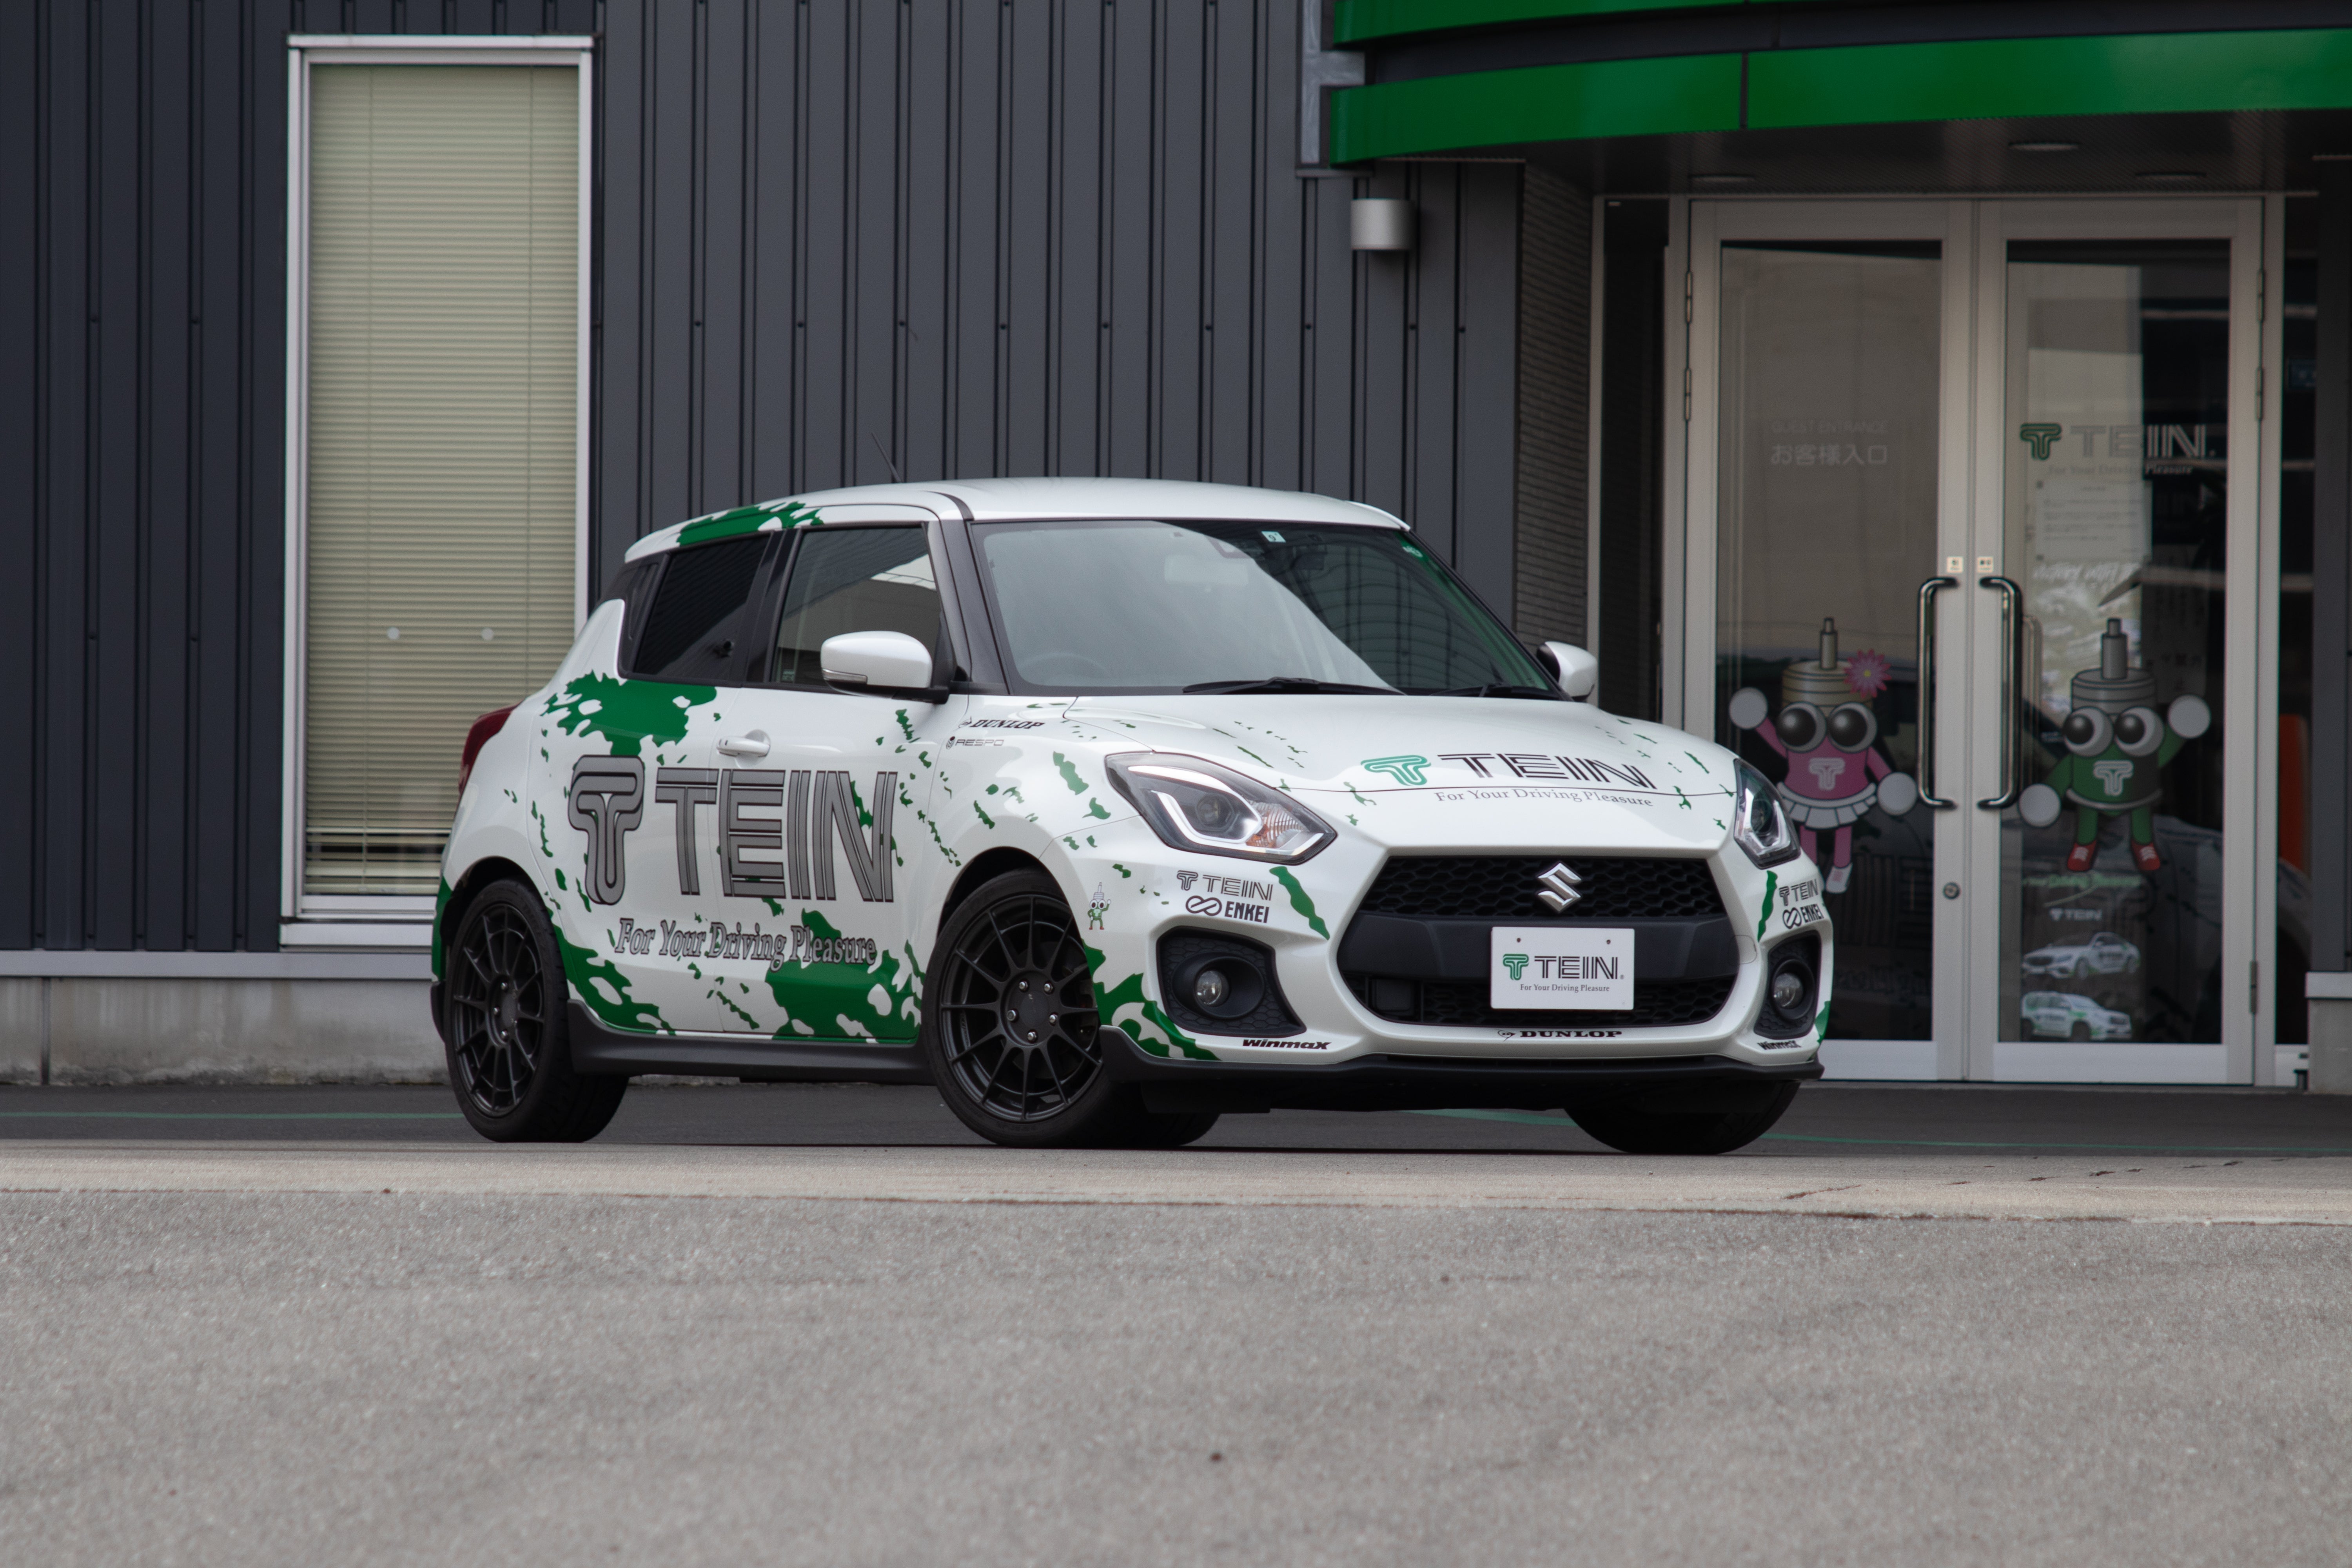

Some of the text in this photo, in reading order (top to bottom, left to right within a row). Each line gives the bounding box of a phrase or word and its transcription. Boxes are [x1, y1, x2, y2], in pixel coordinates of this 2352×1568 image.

[2071, 424, 2206, 459] TEIN
[1770, 443, 1888, 466] お客様入口
[969, 719, 1045, 729] DUNLOP
[1437, 753, 1657, 789] TEIN
[1434, 789, 1654, 807] For Your Driving Pleasure
[655, 767, 898, 903] TEIN
[1202, 874, 1273, 901] TEIN
[1791, 879, 1819, 902] TEIN
[1225, 901, 1270, 924] ENKEI
[615, 918, 877, 972] For Your Driving Pleasure
[1534, 956, 1618, 979] TEIN
[1552, 984, 1579, 993] Driving
